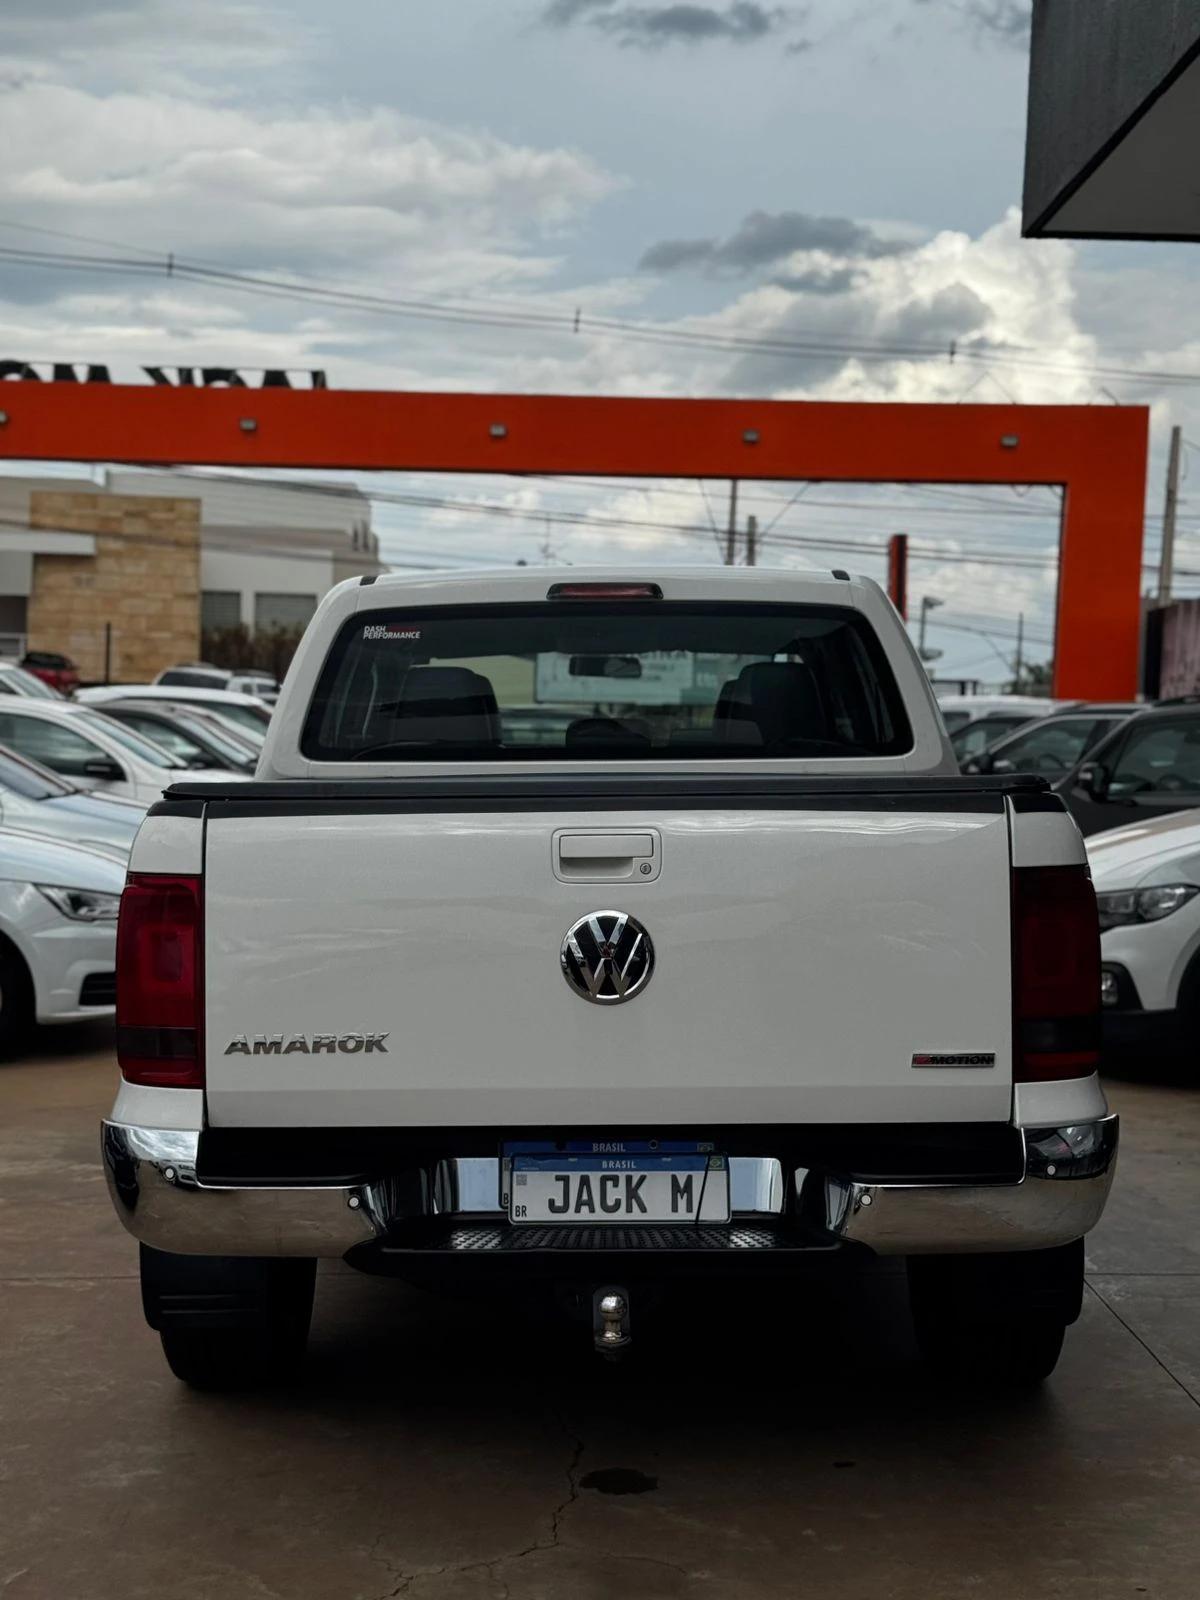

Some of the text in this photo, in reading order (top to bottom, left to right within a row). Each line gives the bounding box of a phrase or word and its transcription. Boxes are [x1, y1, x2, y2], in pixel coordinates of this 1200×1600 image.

[363, 631, 421, 639] PERFORMANCE
[224, 1032, 391, 1055] AMAROK
[592, 1142, 626, 1153] BRASIL
[602, 1160, 636, 1169] BRASIL
[548, 1174, 694, 1214] JACK M
[515, 1205, 528, 1218] BR
